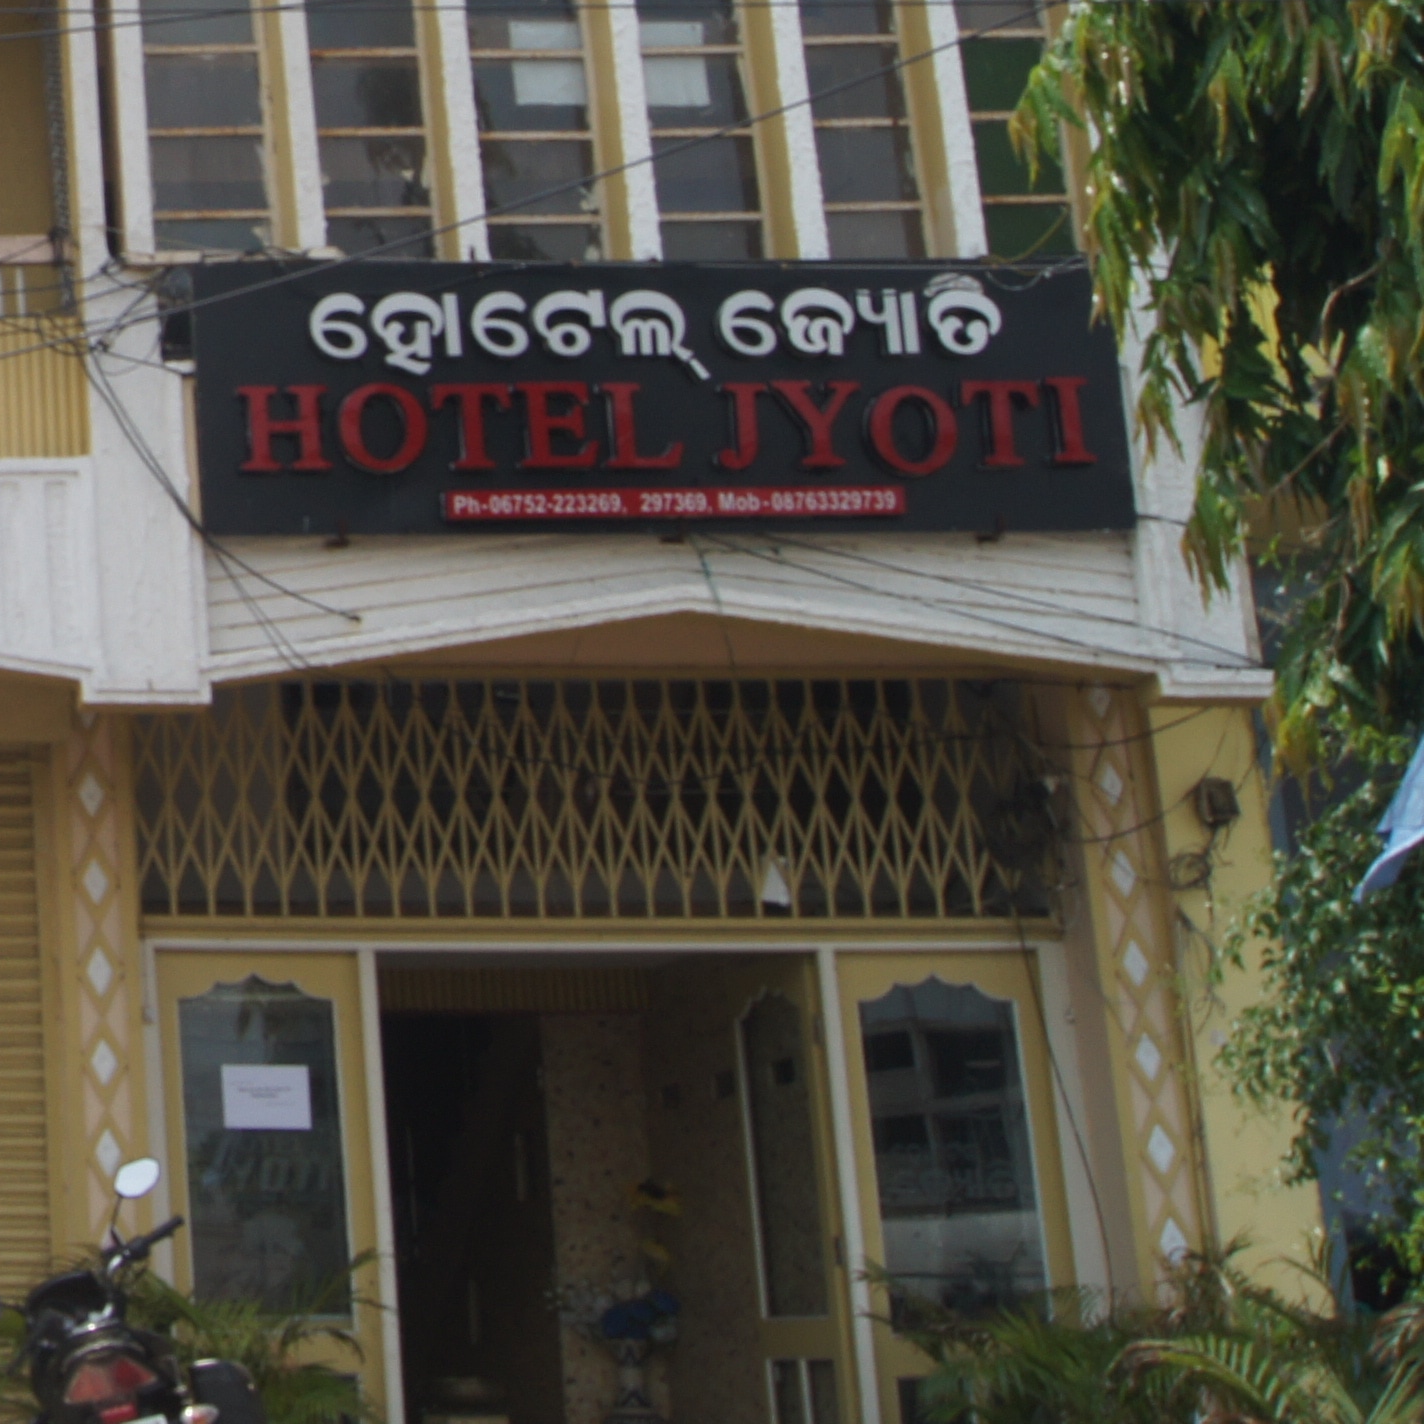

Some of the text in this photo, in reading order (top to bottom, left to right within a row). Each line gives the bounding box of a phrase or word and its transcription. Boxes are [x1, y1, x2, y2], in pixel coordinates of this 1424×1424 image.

[236, 375, 1098, 477] HOTEL JYOTI
[718, 490, 896, 512] Mob-08763329739
